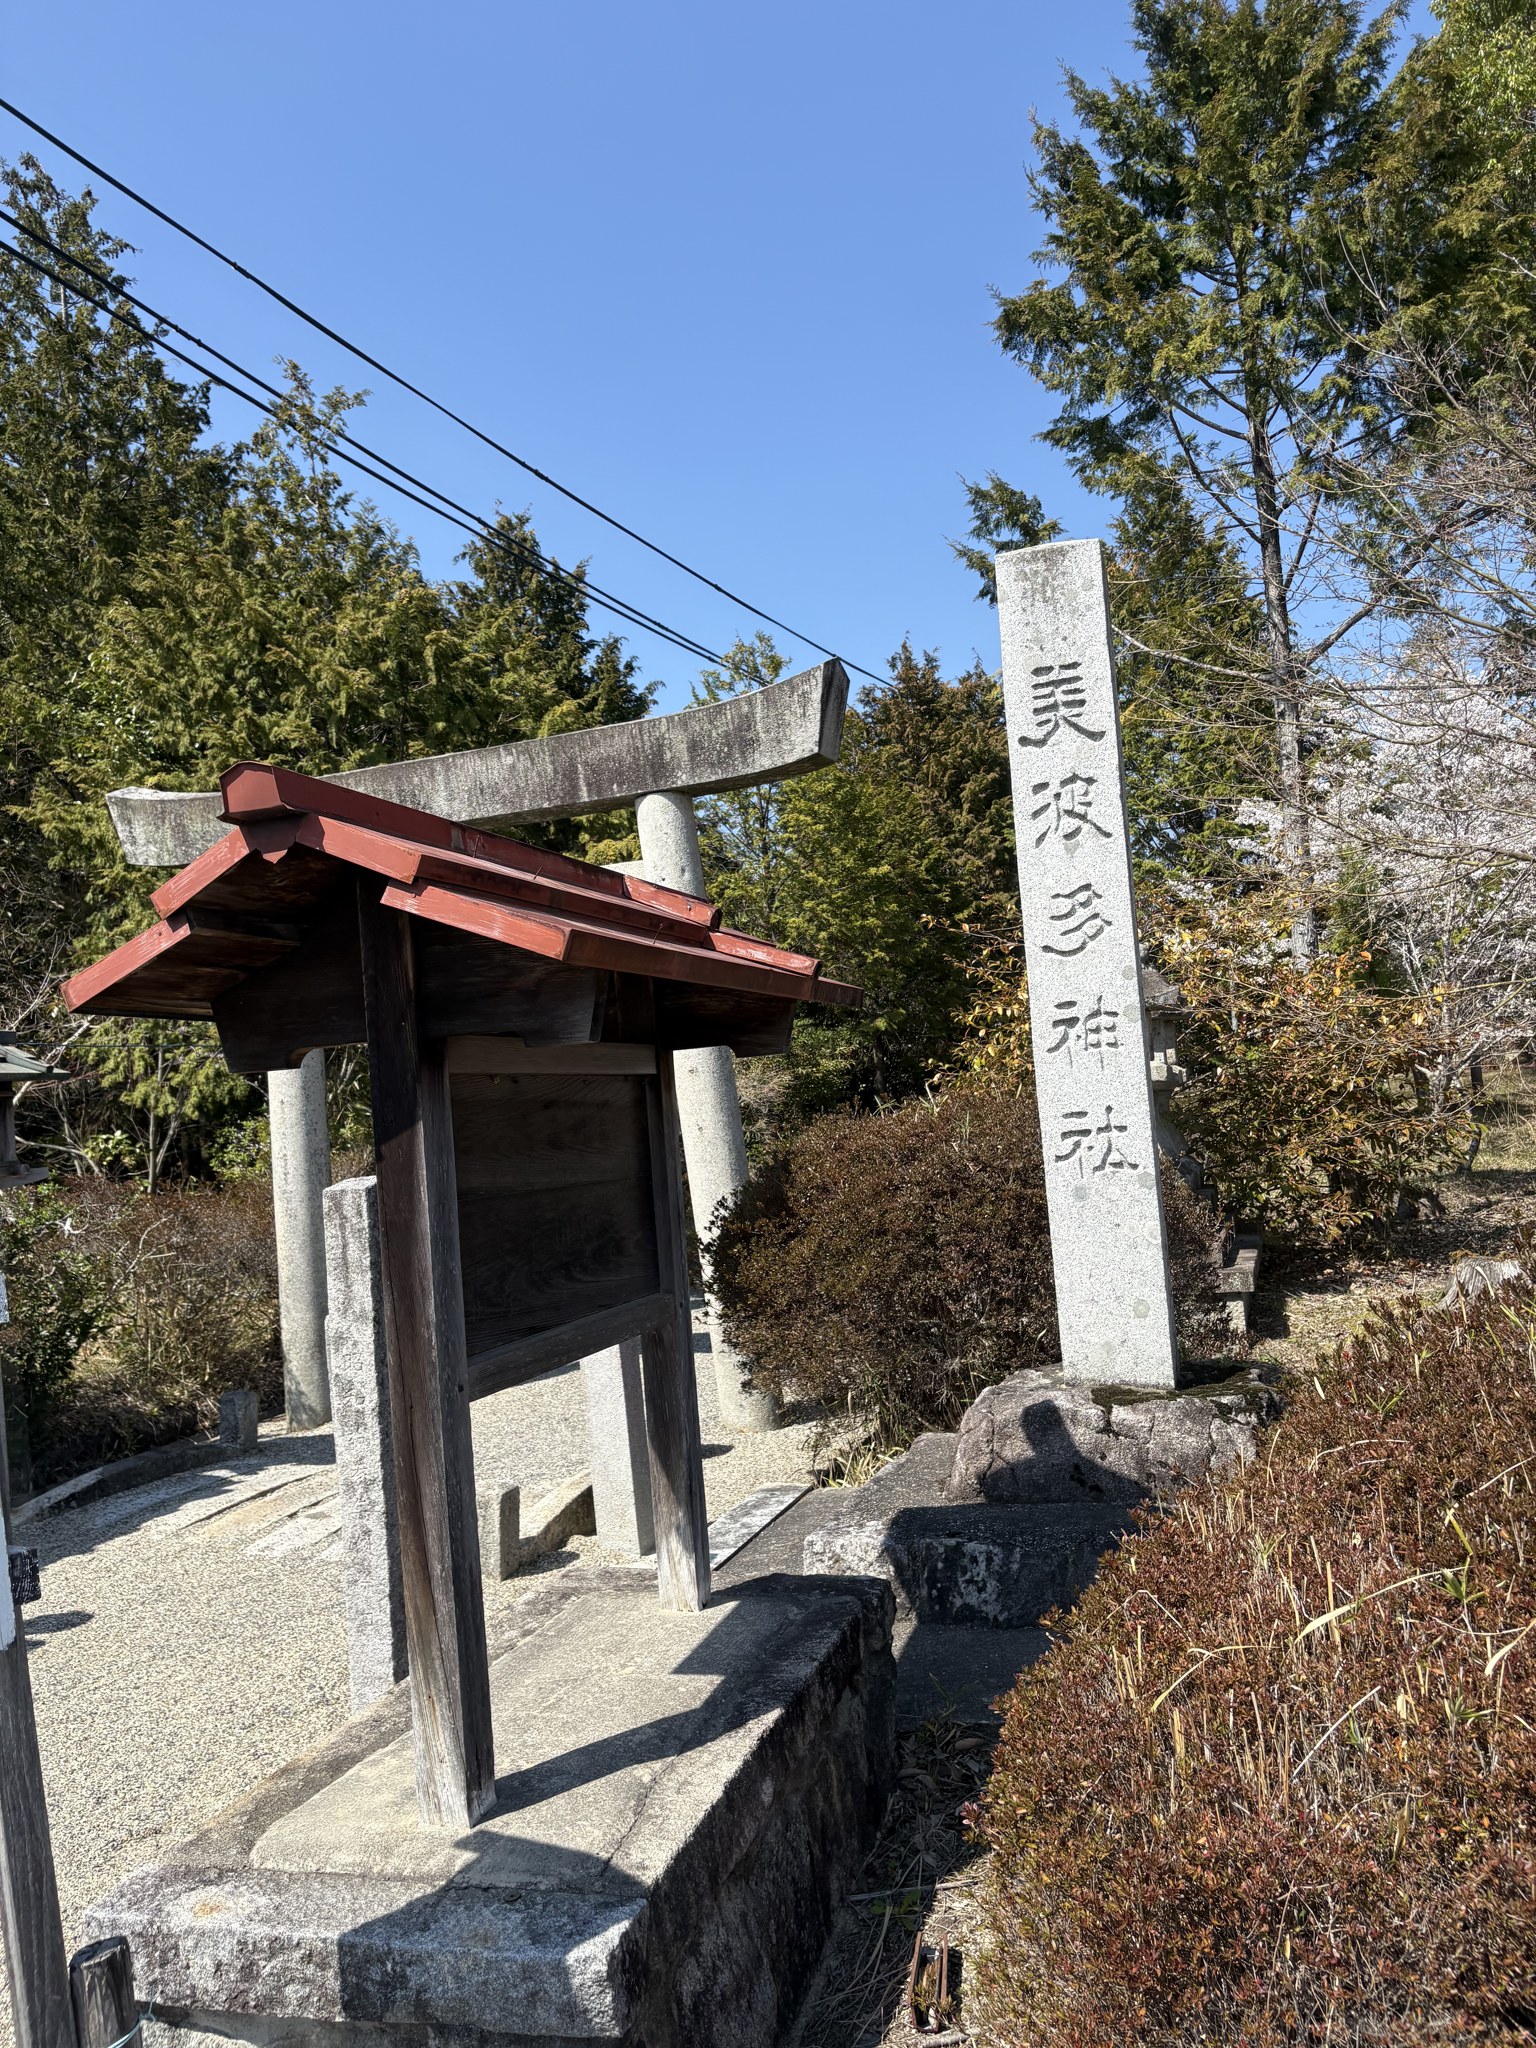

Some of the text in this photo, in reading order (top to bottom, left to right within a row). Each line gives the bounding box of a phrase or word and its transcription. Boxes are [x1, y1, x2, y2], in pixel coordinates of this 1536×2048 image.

[1018, 661, 1139, 1179] 美波多神社
